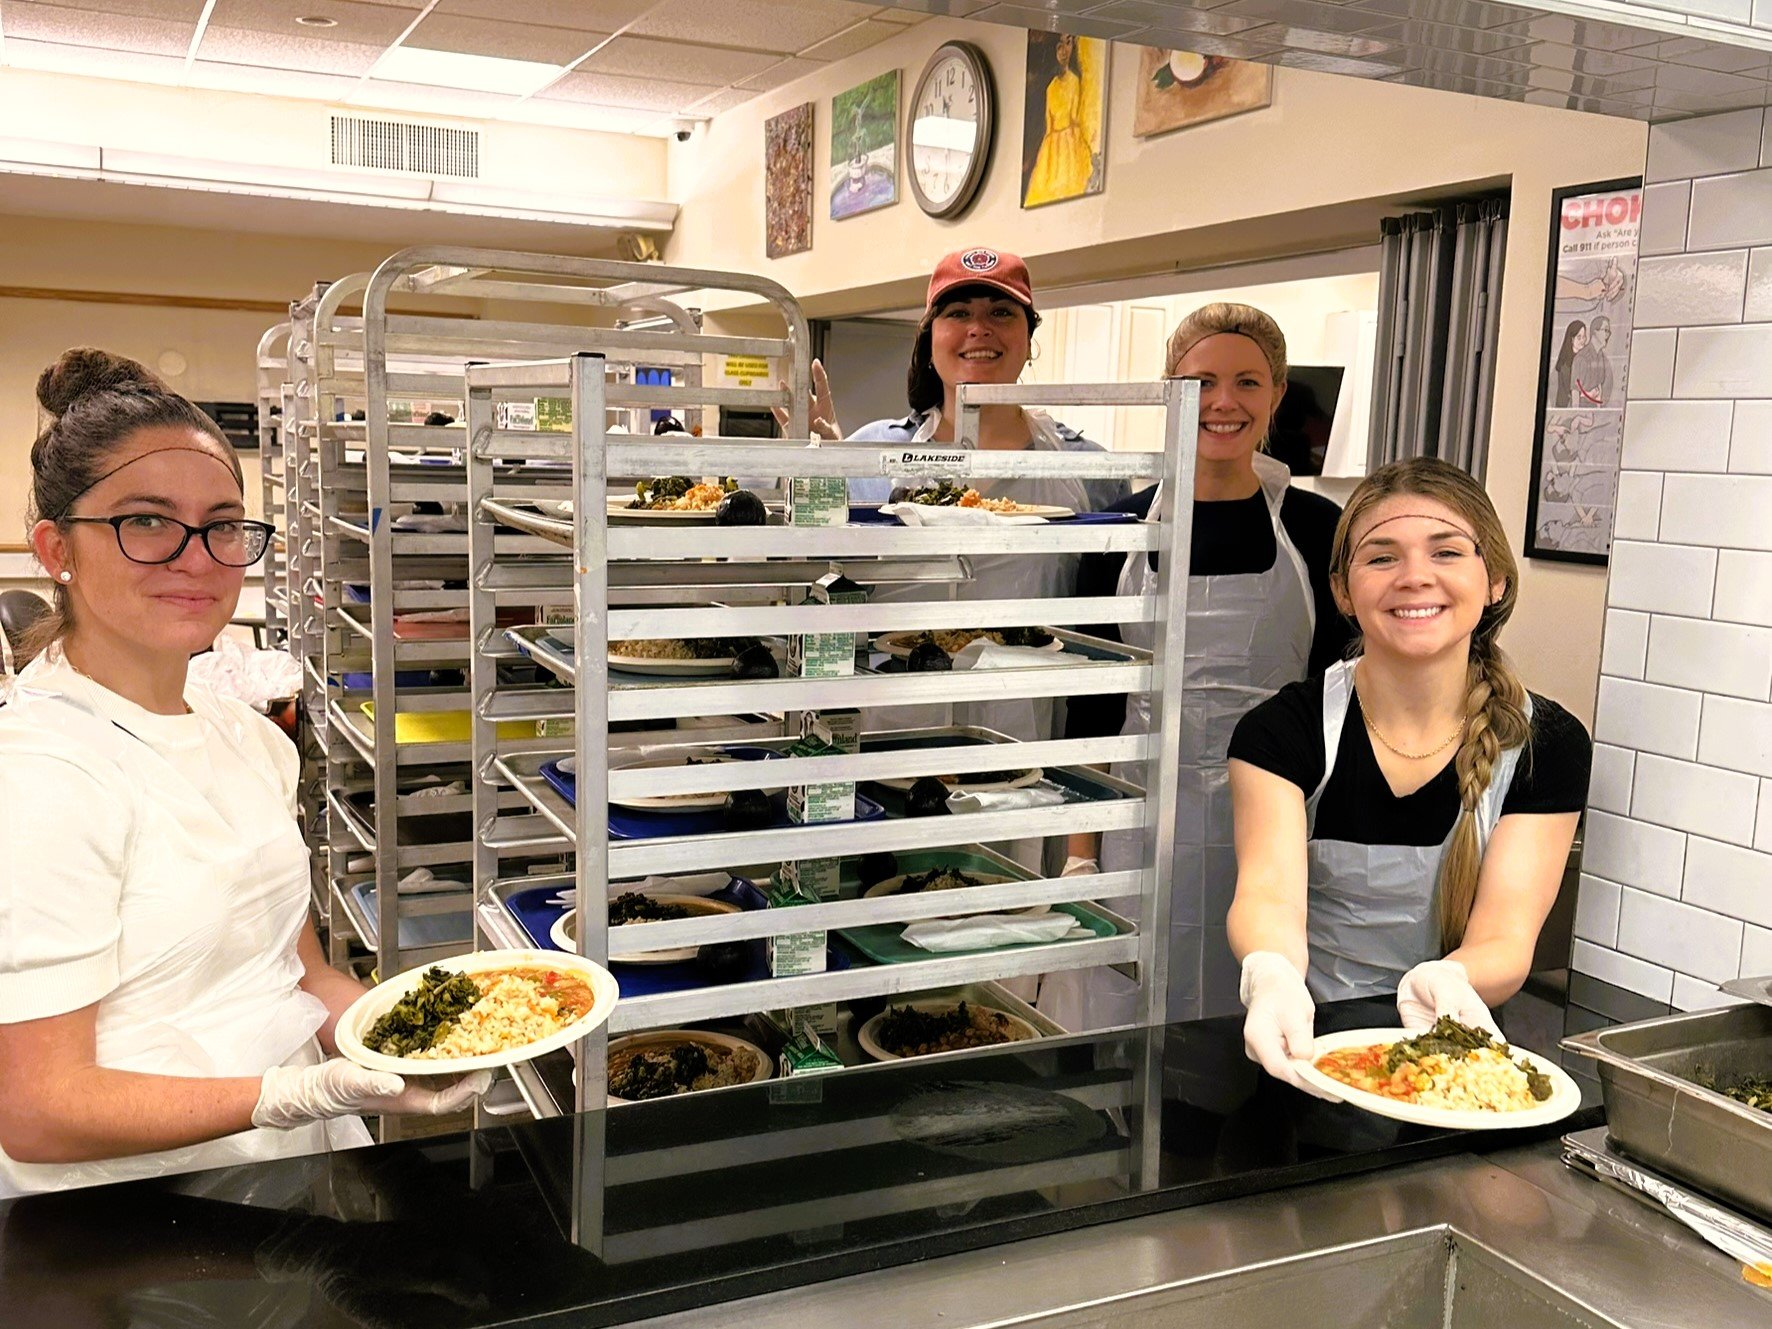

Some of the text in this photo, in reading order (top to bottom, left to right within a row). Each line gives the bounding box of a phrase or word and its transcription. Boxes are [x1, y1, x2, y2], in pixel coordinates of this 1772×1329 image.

[946, 67, 955, 87] 12
[961, 70, 966, 89] 1
[934, 79, 942, 99] 11
[968, 84, 975, 103] 2
[1596, 230, 1611, 240] Ask
[1562, 243, 1578, 253] Call
[1579, 242, 1592, 252] 911
[1593, 241, 1600, 249] if
[1601, 240, 1630, 250] person
[914, 454, 965, 463] LAKESIDE
